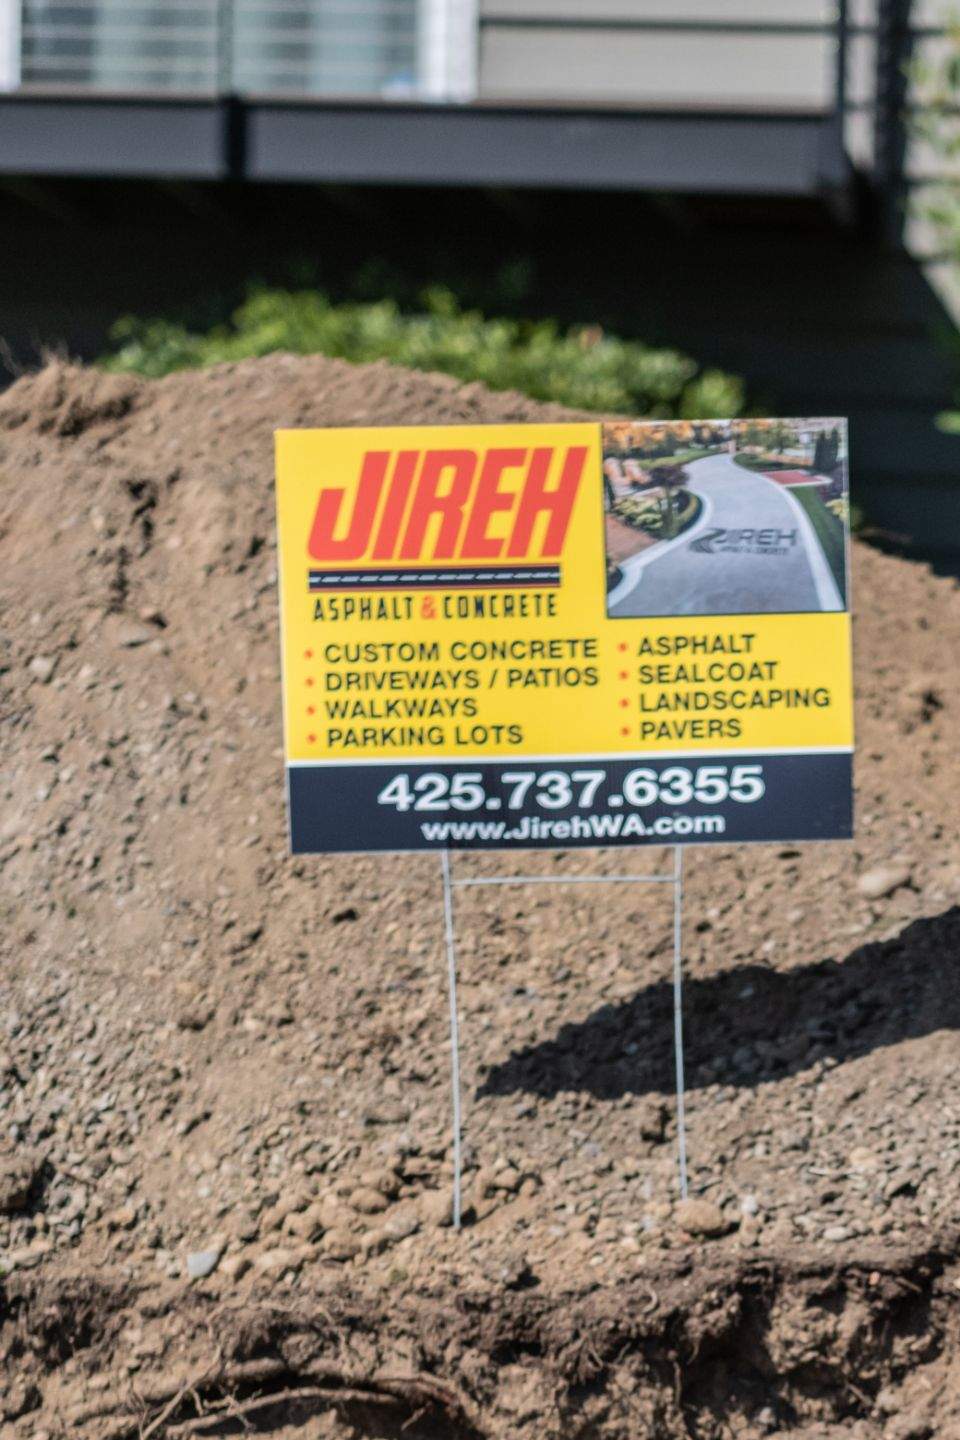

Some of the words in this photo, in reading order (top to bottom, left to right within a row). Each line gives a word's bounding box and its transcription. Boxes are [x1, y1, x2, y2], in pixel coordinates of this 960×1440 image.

[307, 446, 589, 561] JIREH
[313, 595, 413, 621] ASPHALT
[420, 596, 437, 620] &
[444, 593, 557, 619] CONCRETE
[325, 641, 440, 663] CUSTOM
[451, 638, 598, 660] CONCRETE
[638, 634, 756, 656] ASPHALT
[325, 669, 480, 691] DRIVEWAYS
[508, 667, 598, 688] PATIOS
[639, 661, 779, 684] SEALCOAT
[325, 698, 478, 719] WALKWAYS
[640, 688, 830, 712] LANDSCAPING
[327, 726, 445, 747] PARKING
[455, 724, 524, 746] LOTS
[641, 718, 742, 740] PAVERS
[377, 765, 766, 811] 425.737.6355
[420, 814, 726, 840] www.JirehWA.com
